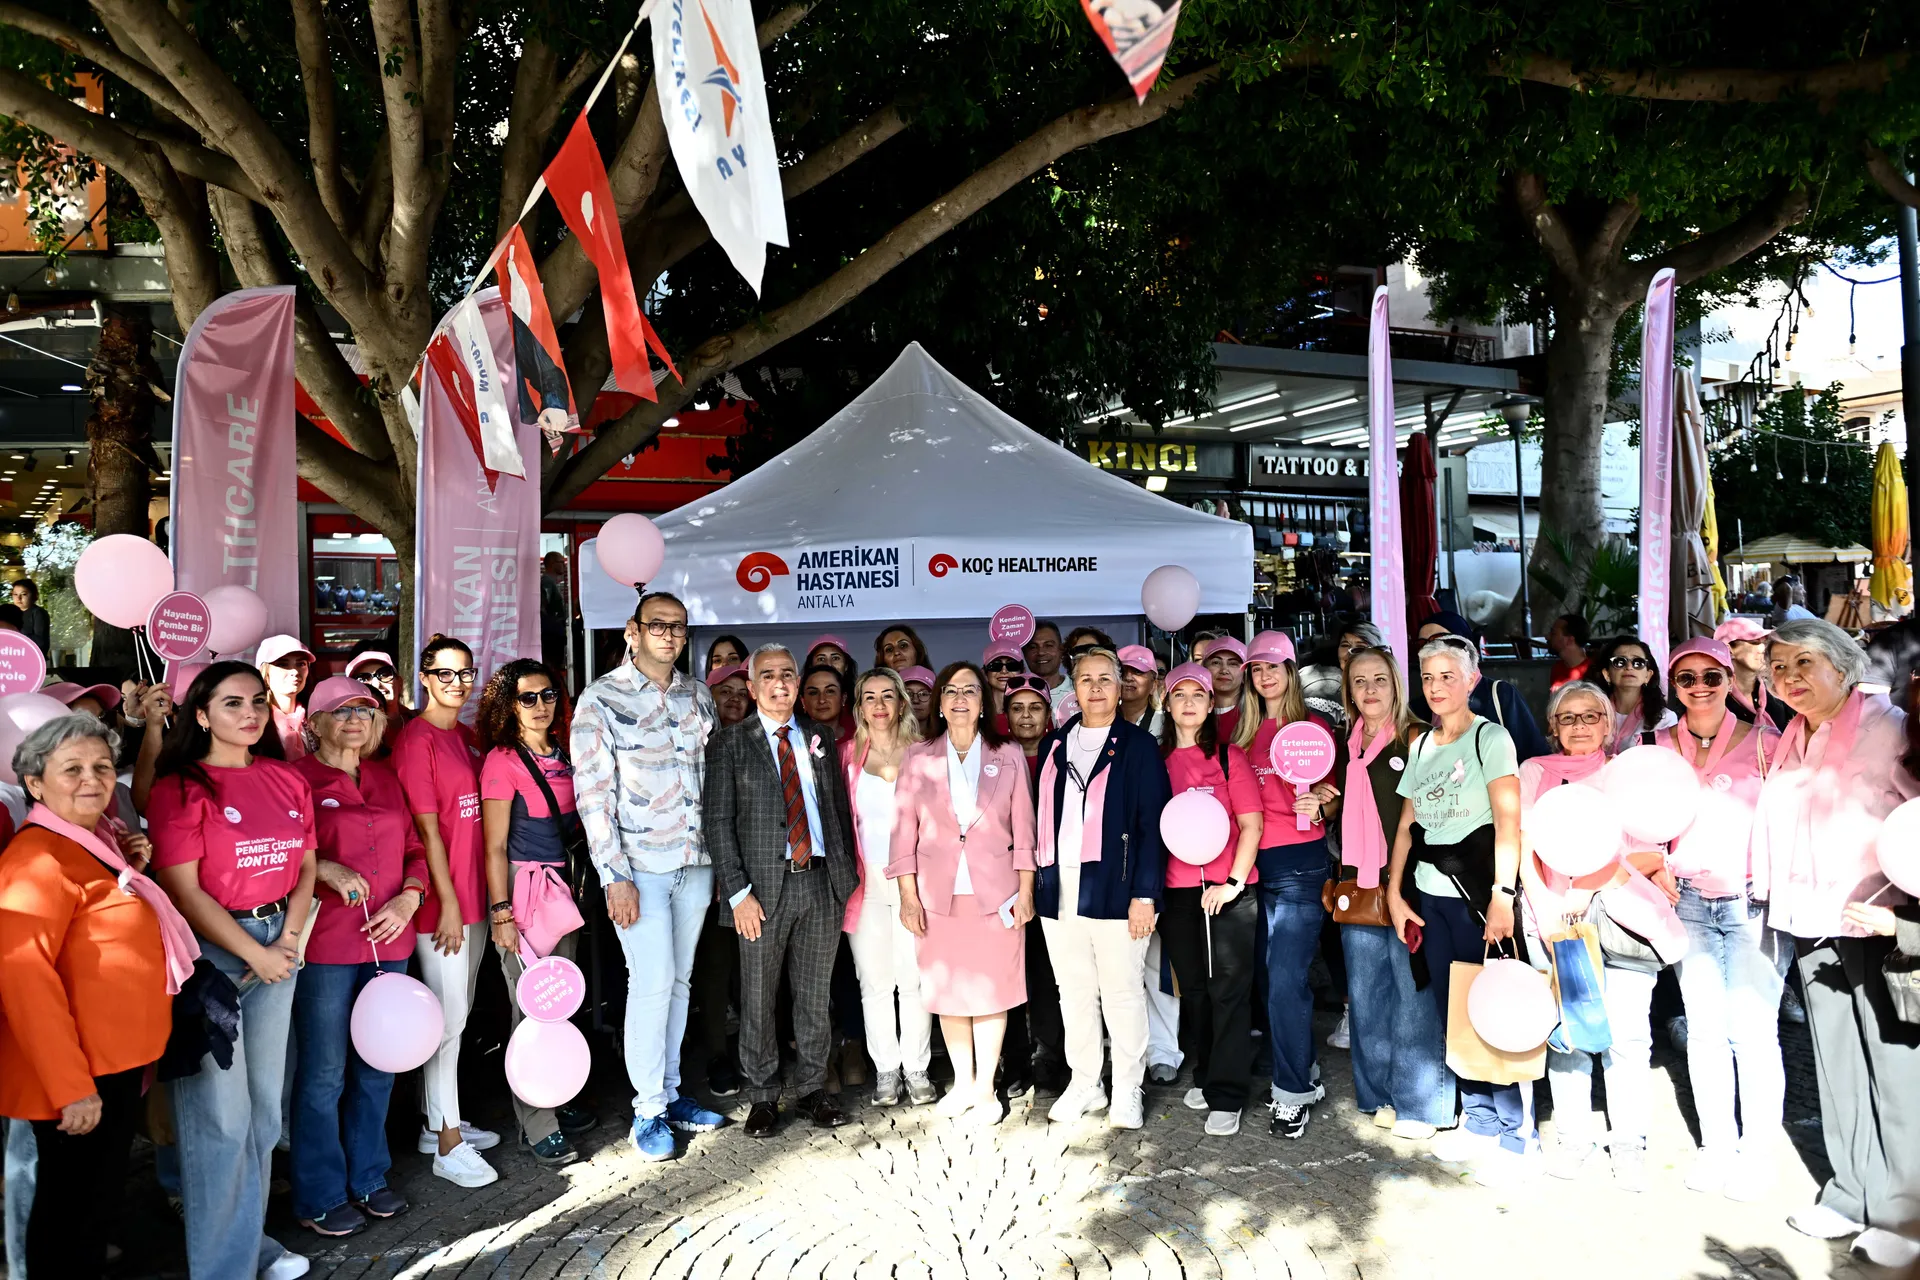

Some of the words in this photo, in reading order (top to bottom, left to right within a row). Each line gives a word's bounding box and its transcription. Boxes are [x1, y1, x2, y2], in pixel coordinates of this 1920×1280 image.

[1263, 455, 1339, 476] TATTOO
[1344, 458, 1358, 477] &
[797, 545, 899, 569] AMERİKAN
[962, 557, 993, 576] KOÇ
[998, 556, 1098, 573] HEALTHCARE
[797, 566, 899, 591] HASTANESİ
[797, 594, 855, 609] ANTALYA
[163, 608, 203, 622] Hayatına
[999, 615, 1027, 624] Kendine
[158, 619, 189, 631] Pembe
[190, 623, 204, 633] Bir
[1001, 622, 1025, 631] Zaman
[160, 630, 199, 645] Dokunuş
[1005, 629, 1021, 638] Ayır!
[1281, 739, 1327, 748] Erteleme,
[1284, 749, 1325, 757] Farkında
[1297, 758, 1311, 767] Ol!
[235, 844, 270, 856] PEMBE
[533, 974, 557, 991] Yaşa
[534, 978, 567, 1004] Sağlıklı
[552, 986, 574, 1002] Fark
